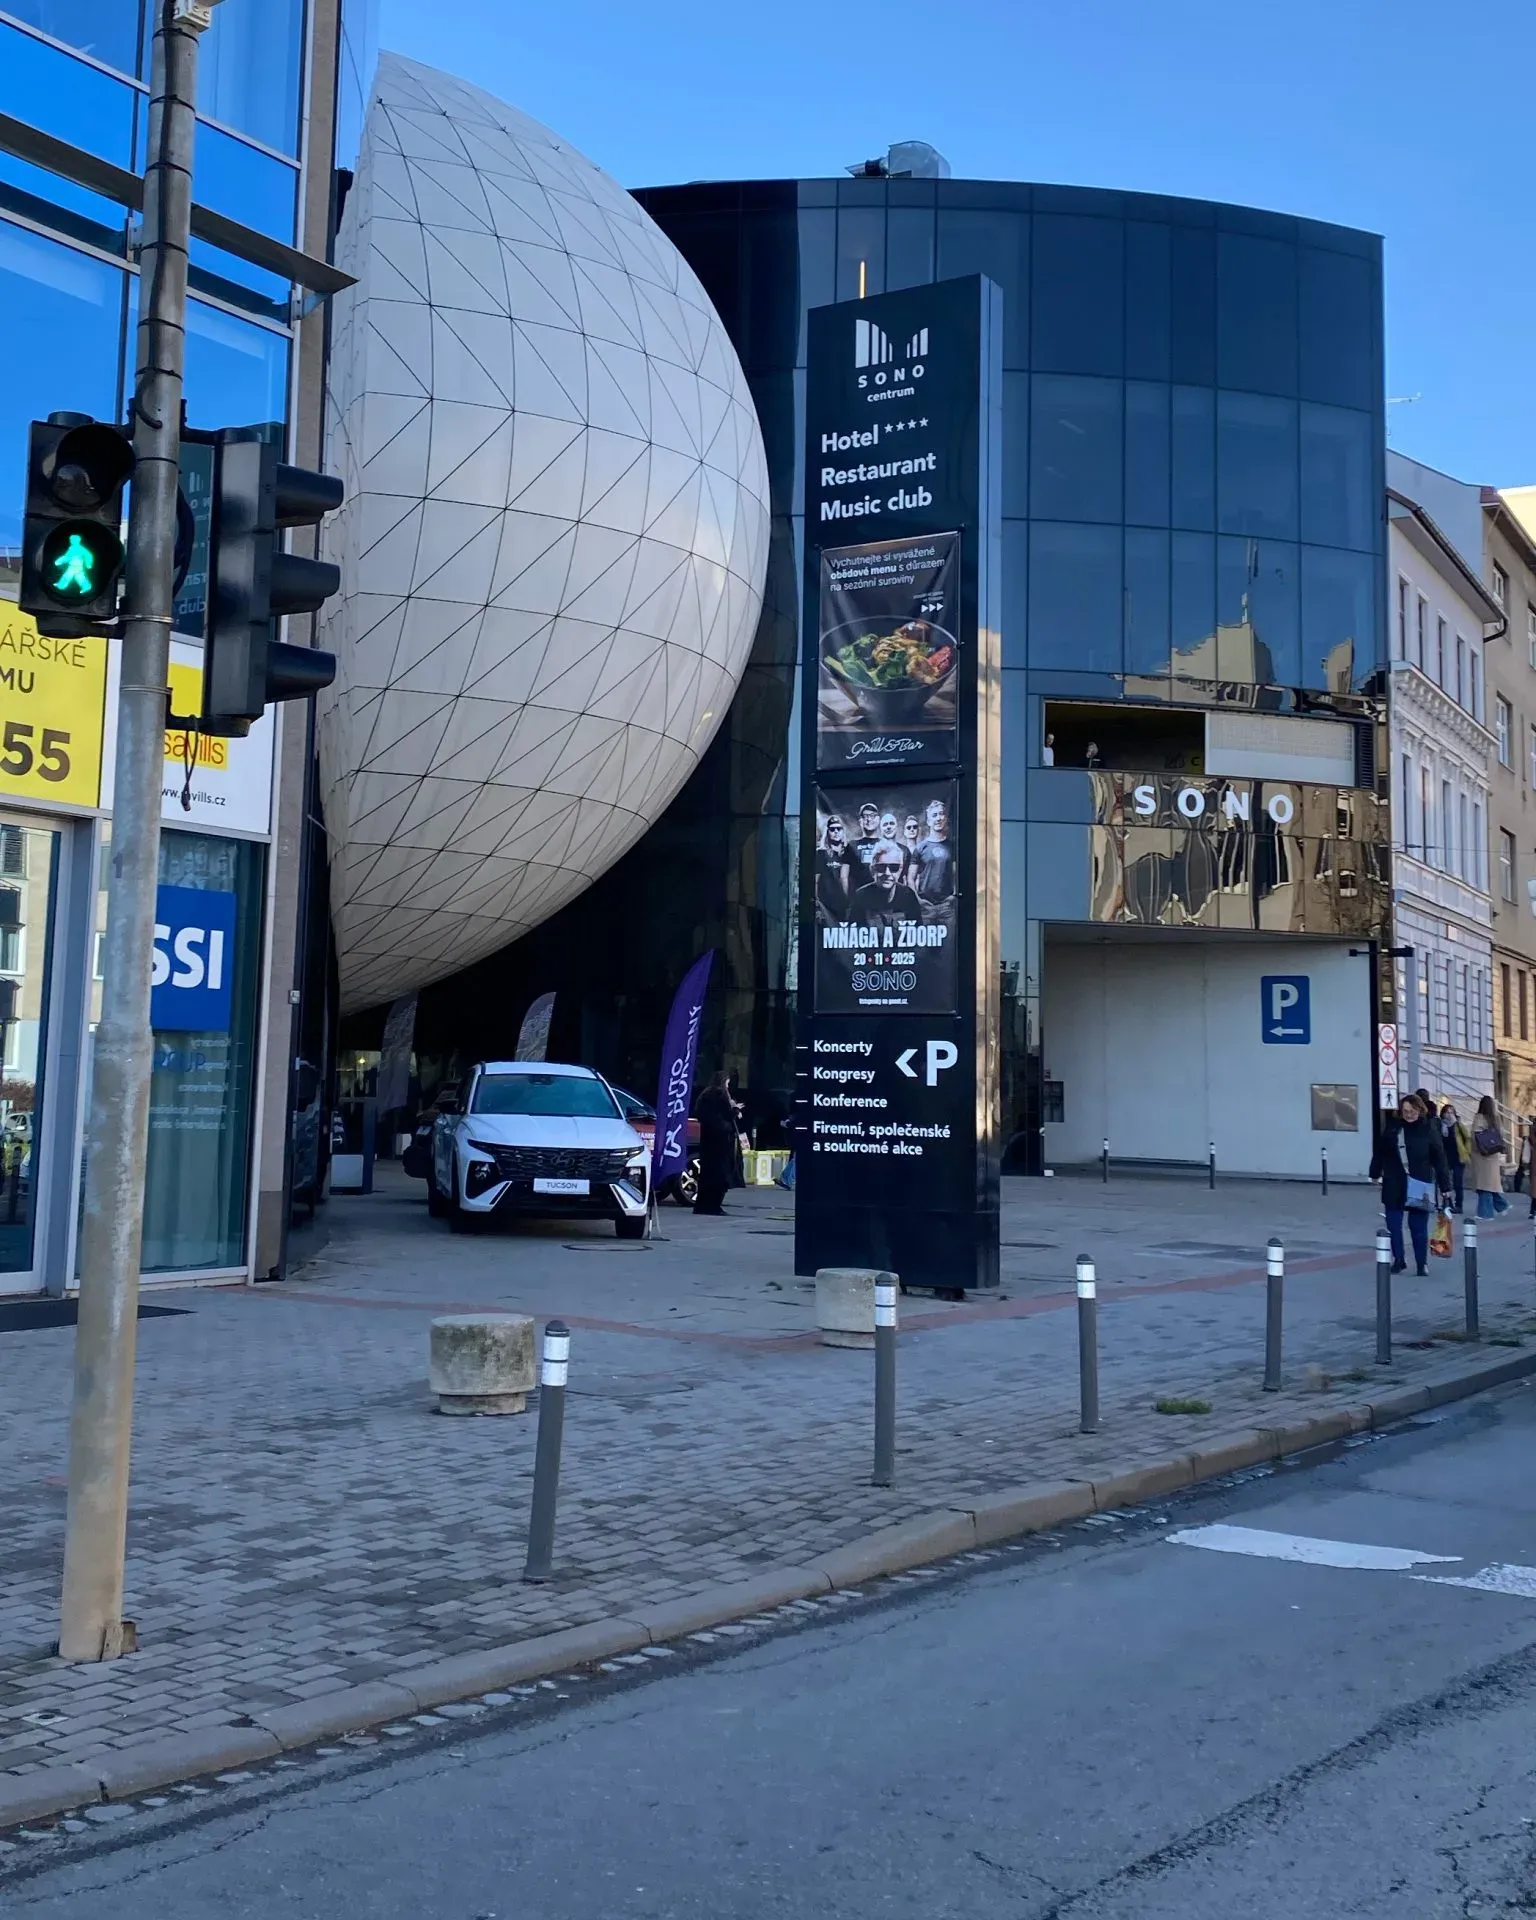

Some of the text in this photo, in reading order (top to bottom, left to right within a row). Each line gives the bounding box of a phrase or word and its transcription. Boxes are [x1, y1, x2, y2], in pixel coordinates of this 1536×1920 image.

[858, 364, 925, 388] SONO
[867, 386, 915, 403] centrum
[821, 424, 879, 453] Hotel
[821, 452, 937, 487] Restaurant
[820, 486, 933, 521] Music club
[831, 546, 936, 569] Vychutnejte si vyvážené
[830, 568, 869, 580] obědové
[870, 565, 897, 575] menu
[906, 558, 945, 570] důrazem
[830, 574, 915, 592] na sezónní suroviny
[0, 721, 71, 783] 55
[1135, 785, 1295, 824] SONO
[823, 919, 947, 949] MŇÁGA A ŽĎORP
[851, 970, 917, 991] SONO
[1271, 983, 1298, 1020] P
[813, 1040, 873, 1056] Koncerty
[926, 1040, 958, 1086] P
[813, 1067, 875, 1084] Kongresy
[813, 1094, 888, 1108] Konference
[813, 1121, 950, 1139] Firemní, společenské
[812, 1139, 923, 1155] a soukromé akce
[546, 1181, 578, 1189] TUCSON
